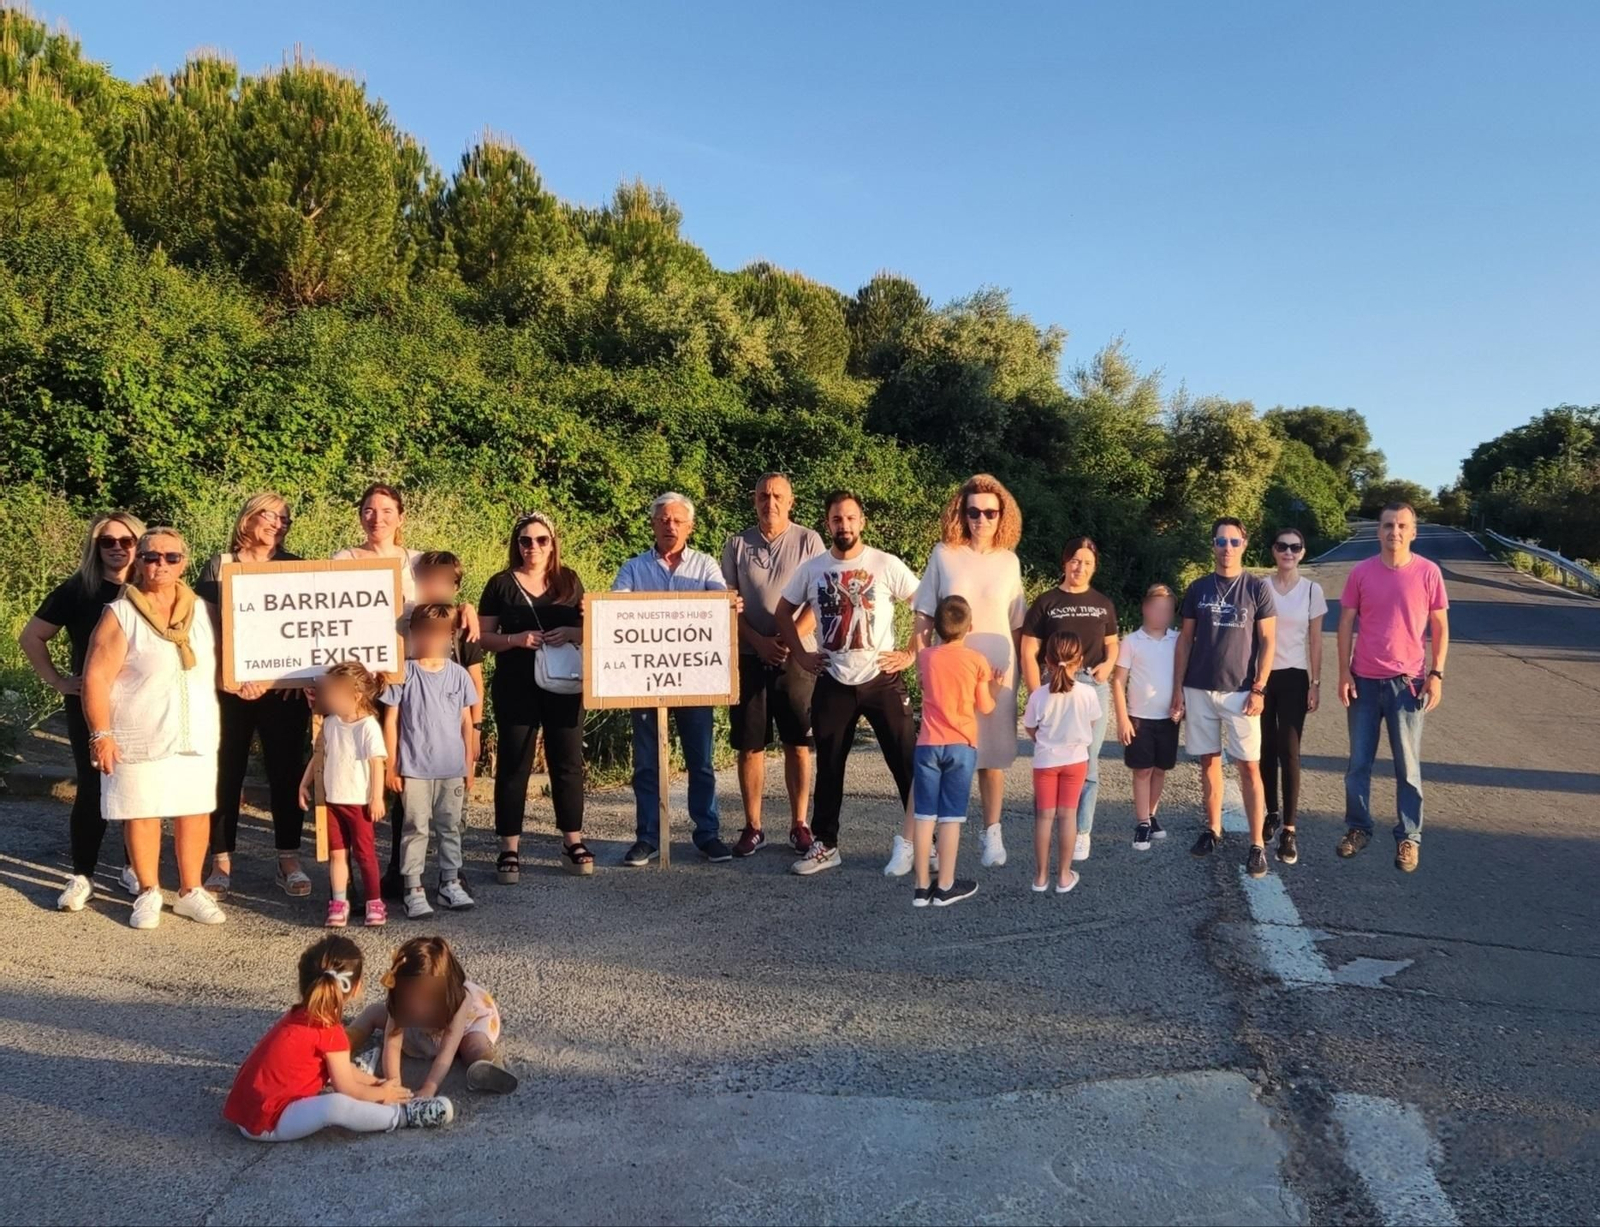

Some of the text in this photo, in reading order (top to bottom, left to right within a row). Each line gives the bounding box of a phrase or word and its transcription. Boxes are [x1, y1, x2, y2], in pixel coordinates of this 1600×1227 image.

[239, 590, 389, 612] LA BARRIADA
[616, 611, 713, 620] POR NUESTR@S HIJ@S
[280, 619, 353, 639] CERET
[613, 623, 713, 644] SOLUCIÓN
[244, 645, 389, 670] TAMBIÉN EXISTE
[603, 661, 611, 670] A
[613, 661, 627, 670] LA
[646, 672, 683, 691] ¡YA!
